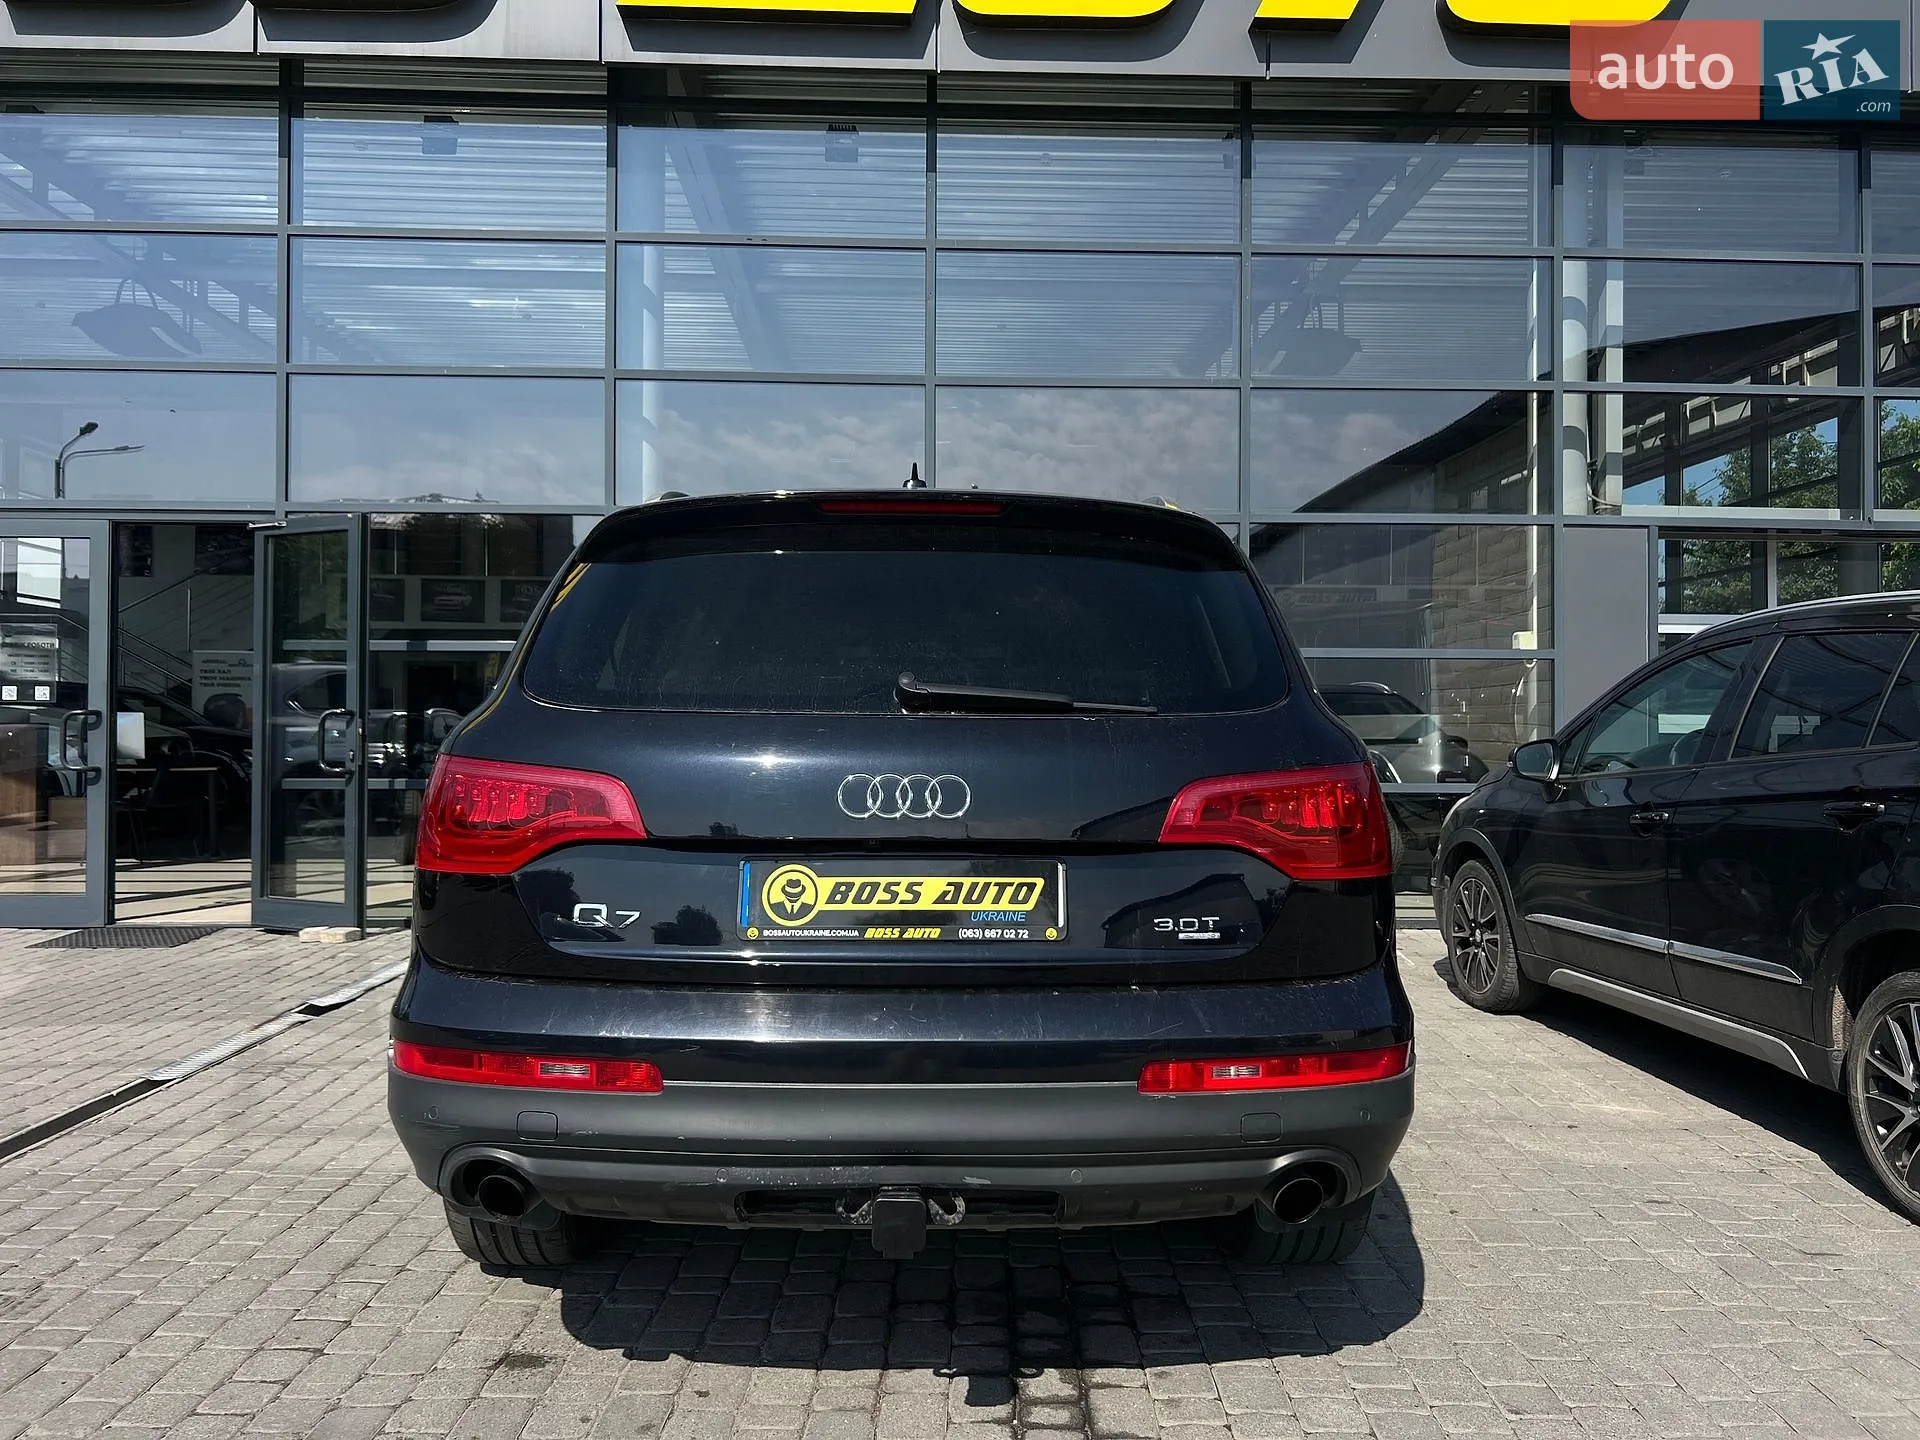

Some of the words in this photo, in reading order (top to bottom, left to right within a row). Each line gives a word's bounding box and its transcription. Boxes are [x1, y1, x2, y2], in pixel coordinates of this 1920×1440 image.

[825, 881, 924, 905] BOSS
[931, 881, 1038, 905] AUTO
[572, 903, 641, 929] Q7
[971, 911, 1027, 922] UKRAINE
[863, 927, 901, 939] BOSS
[902, 927, 942, 939] AUTO
[958, 927, 983, 940] (063)
[1003, 929, 1016, 939] 02
[1017, 929, 1029, 939] 72
